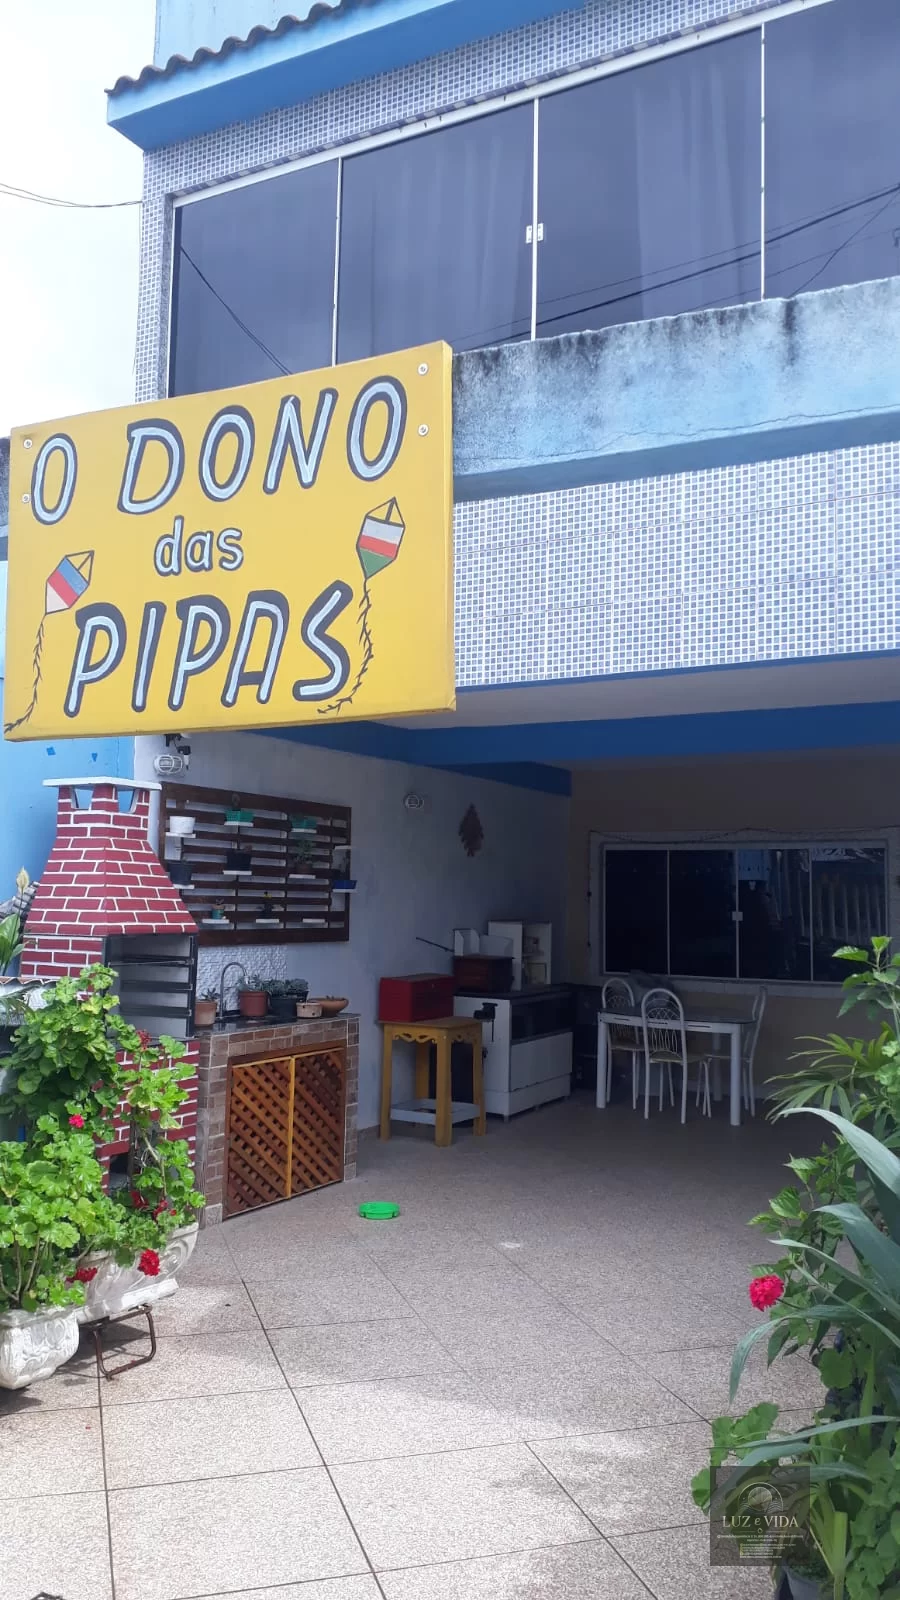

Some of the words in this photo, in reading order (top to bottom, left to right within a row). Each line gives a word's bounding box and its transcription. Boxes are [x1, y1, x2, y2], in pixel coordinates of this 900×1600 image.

[31, 432, 78, 525] O
[118, 375, 408, 514] DONO
[154, 515, 244, 576] das
[64, 579, 354, 718] PIPAS
